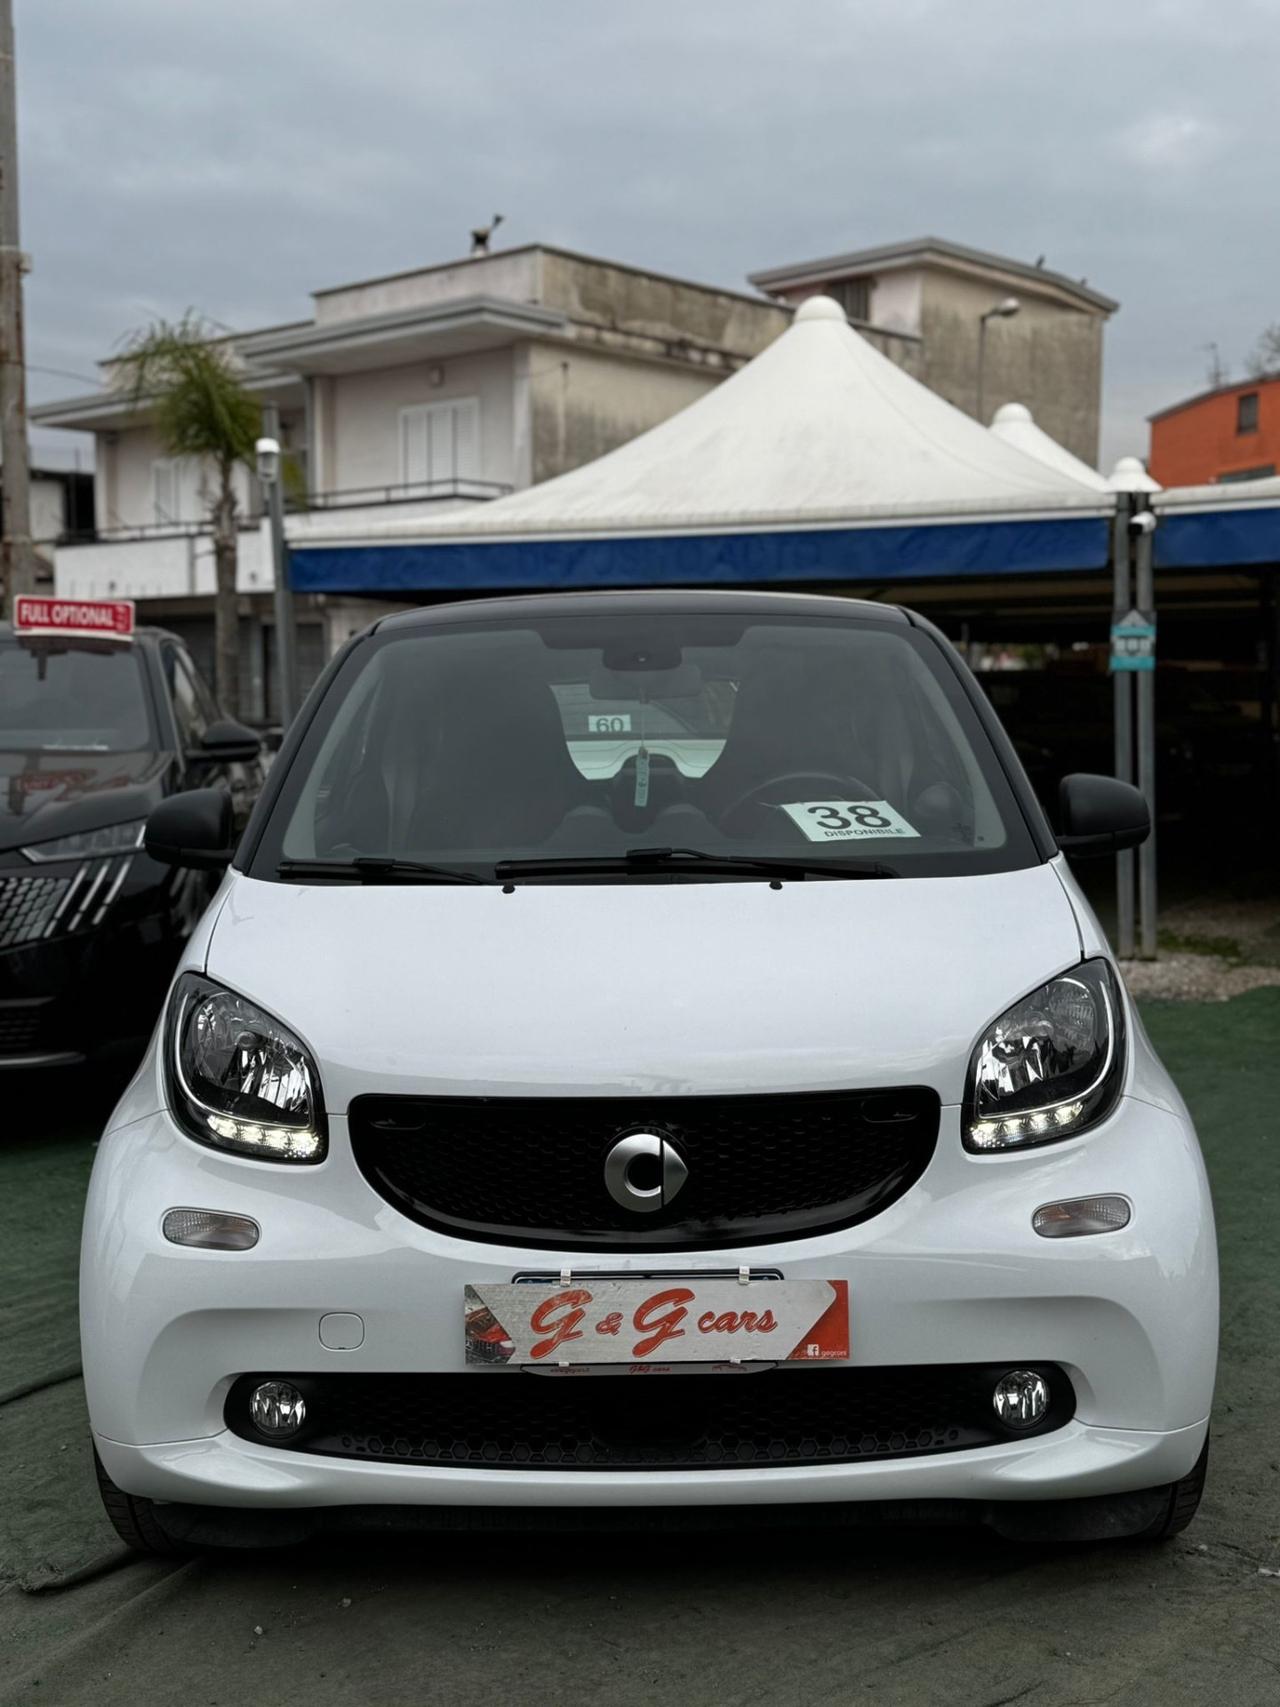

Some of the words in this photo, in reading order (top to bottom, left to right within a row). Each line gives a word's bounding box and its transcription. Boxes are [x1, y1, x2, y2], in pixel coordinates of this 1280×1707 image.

[21, 603, 49, 622] FULL
[51, 605, 114, 626] OPTIONAL
[807, 805, 892, 829] 38
[824, 828, 906, 837] DISPONIBILE
[529, 1289, 594, 1360] G
[595, 1311, 624, 1336] &
[631, 1287, 696, 1358] G
[697, 1309, 778, 1334] cars
